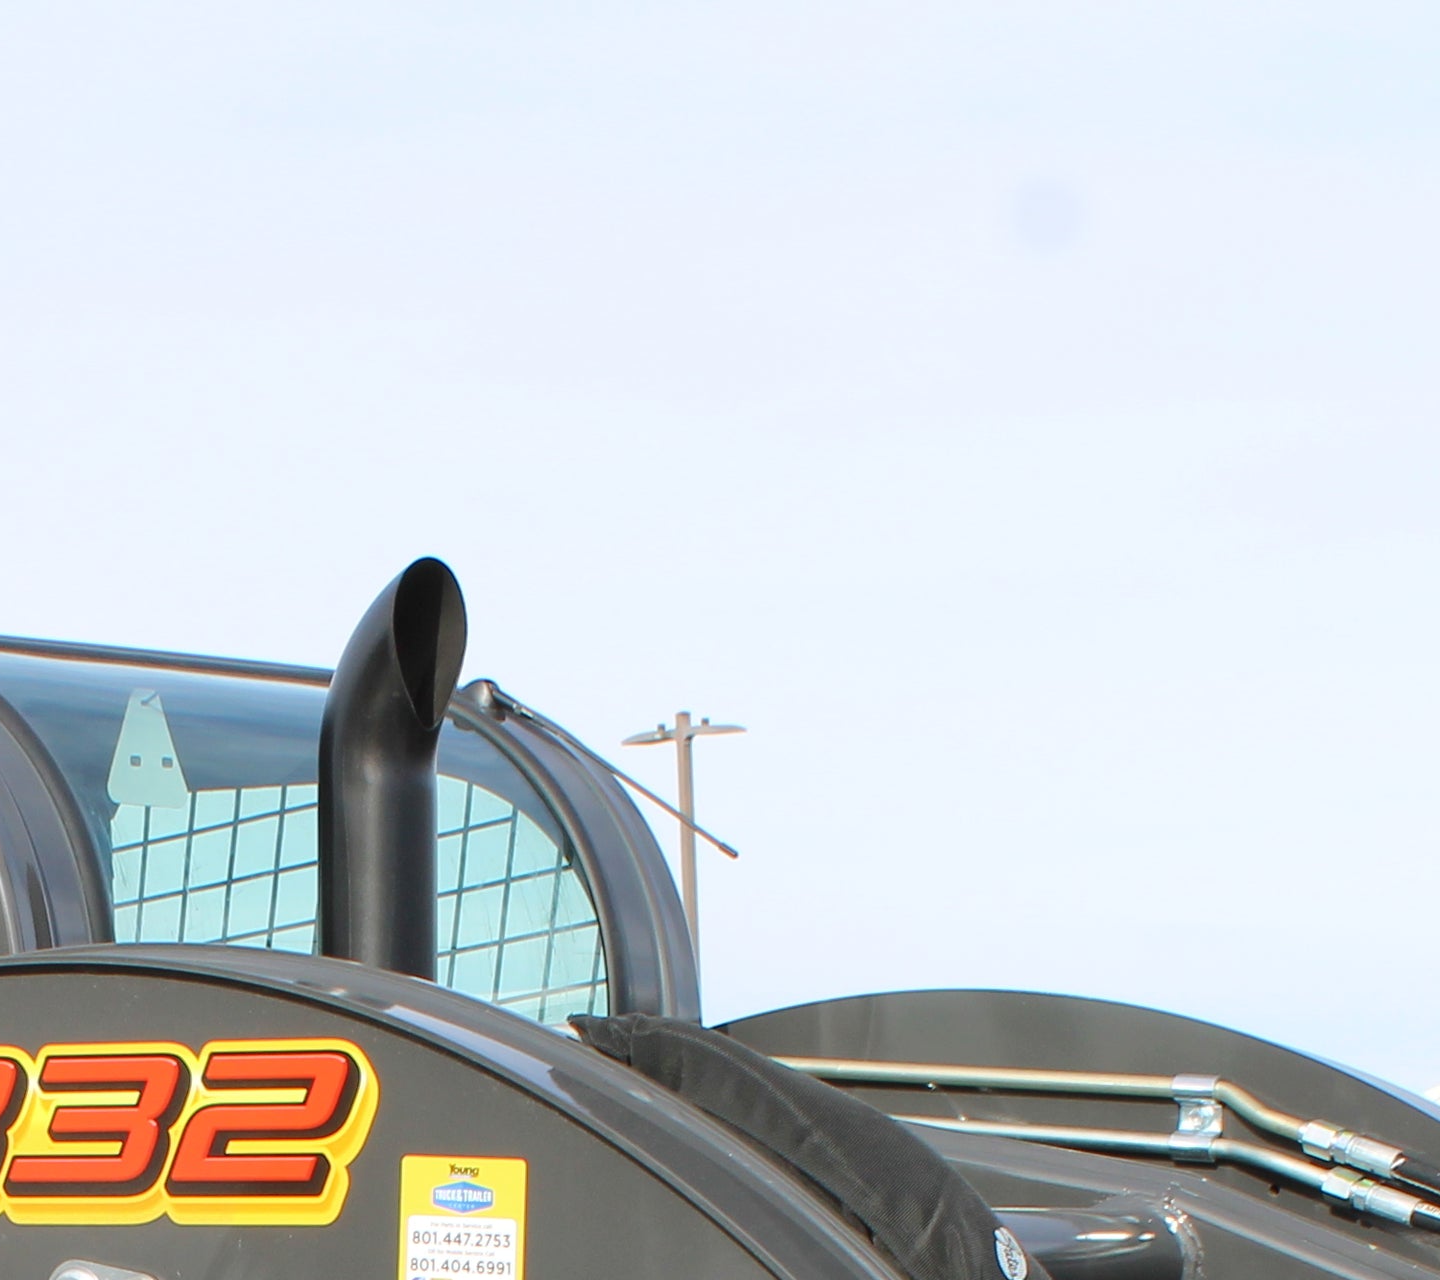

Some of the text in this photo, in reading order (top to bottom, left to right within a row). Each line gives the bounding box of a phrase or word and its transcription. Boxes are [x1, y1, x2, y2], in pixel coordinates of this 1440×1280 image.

[449, 1163, 479, 1177] Young
[412, 1230, 511, 1248] 801.447.2753
[410, 1257, 511, 1275] 801.404.6991
